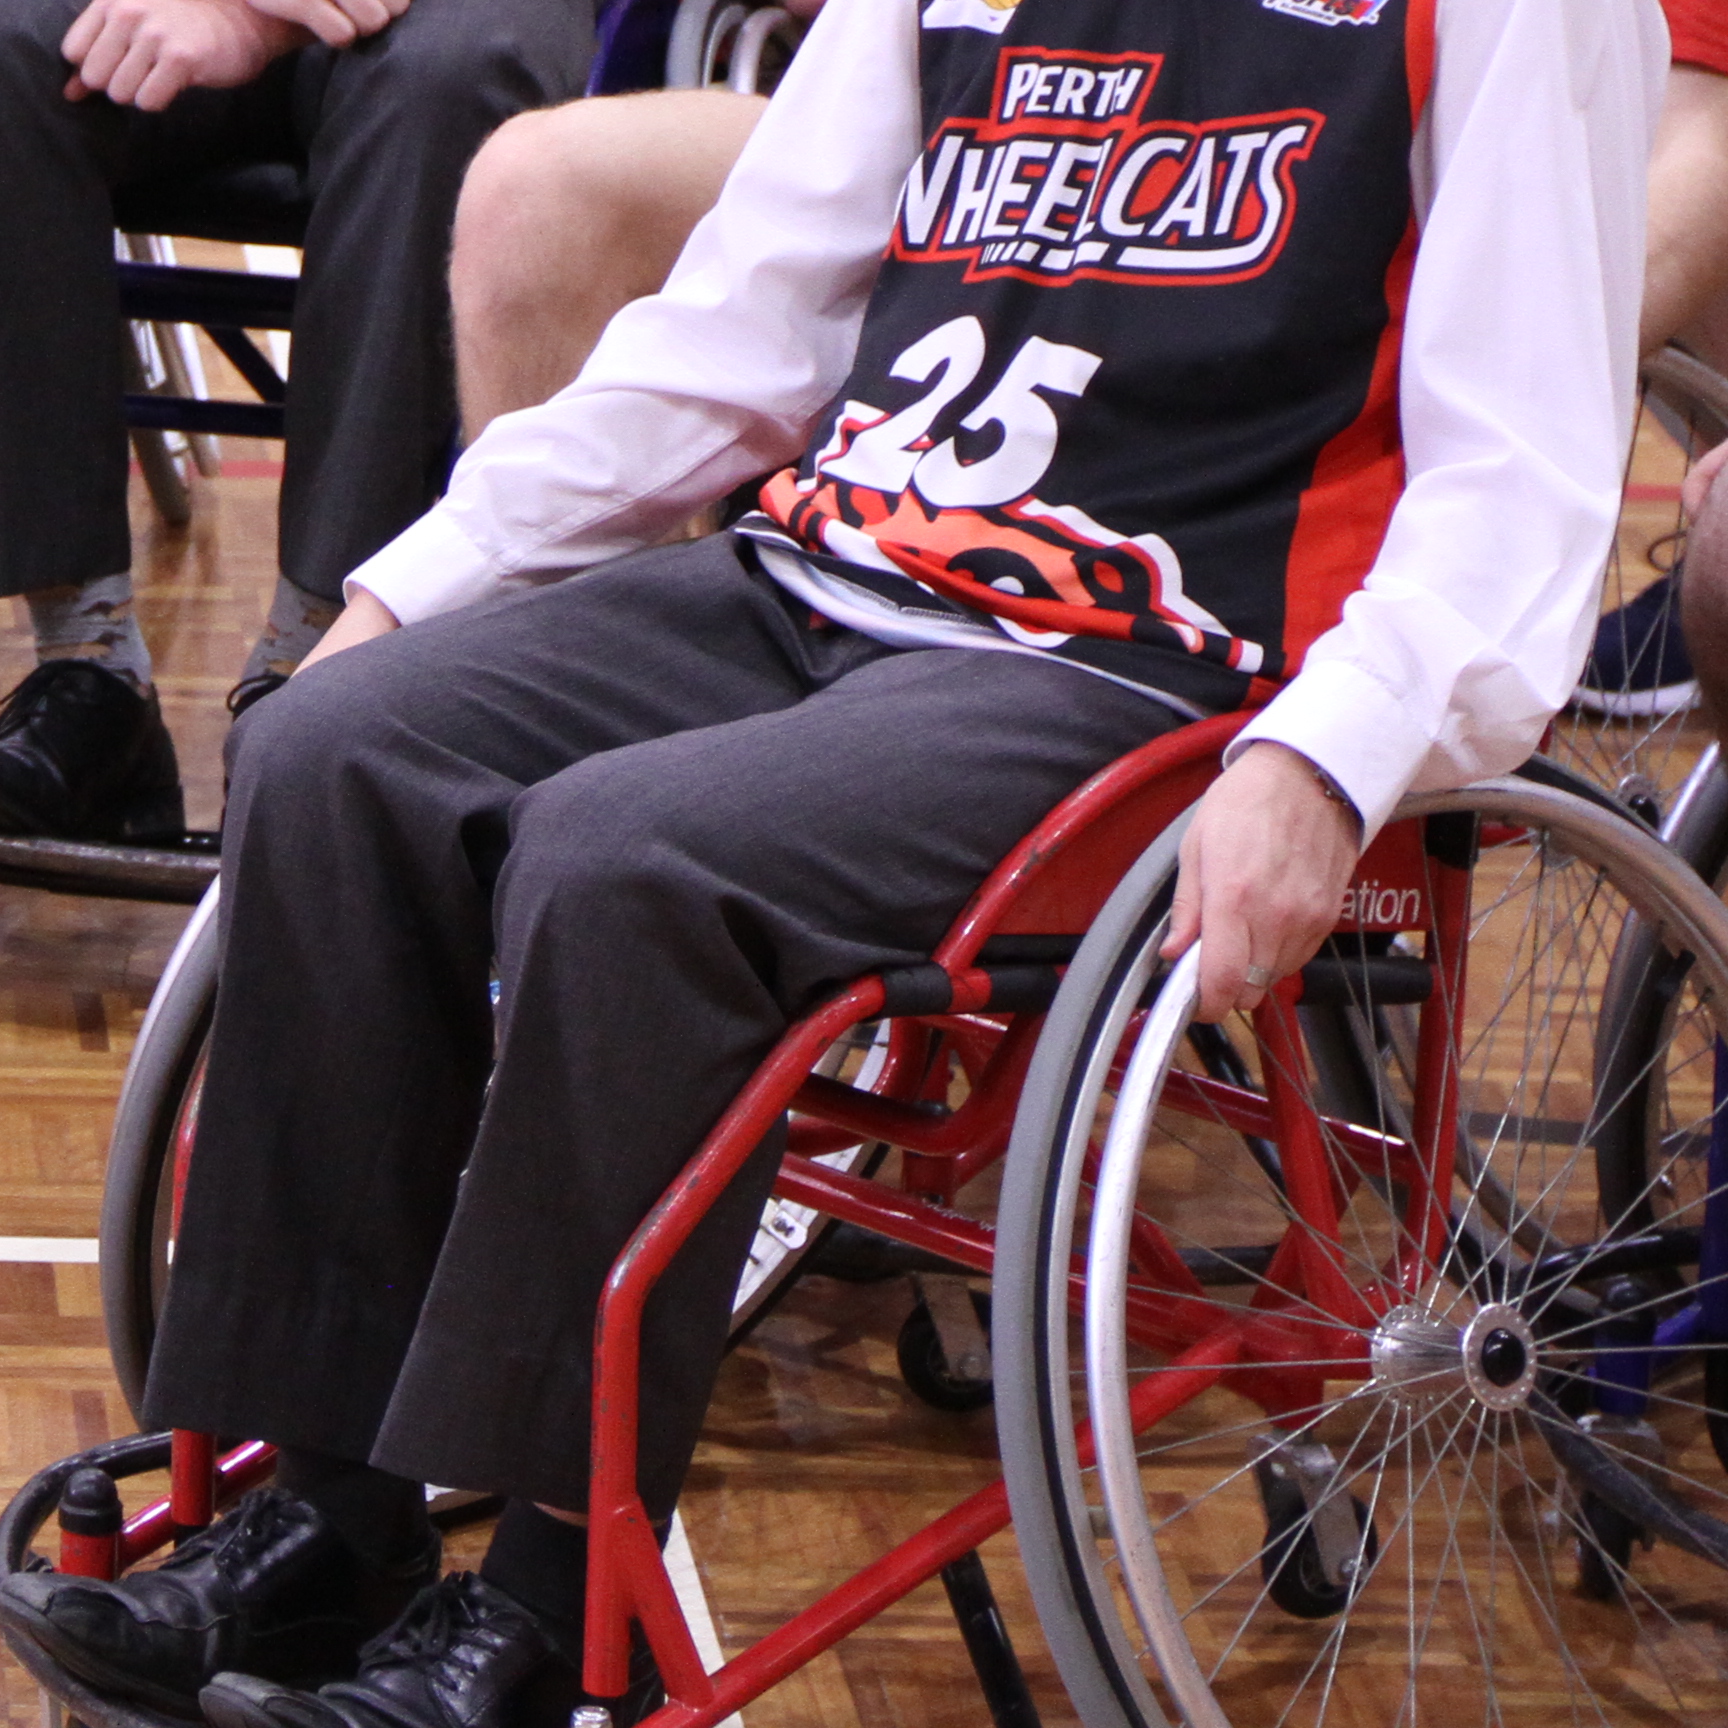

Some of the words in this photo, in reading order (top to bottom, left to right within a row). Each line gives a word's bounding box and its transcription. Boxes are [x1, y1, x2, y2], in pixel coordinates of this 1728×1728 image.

[1003, 63, 1144, 122] PERTH
[898, 124, 1309, 250] WHEELCATS
[818, 315, 1103, 507] 25
[1341, 879, 1422, 924] ation
